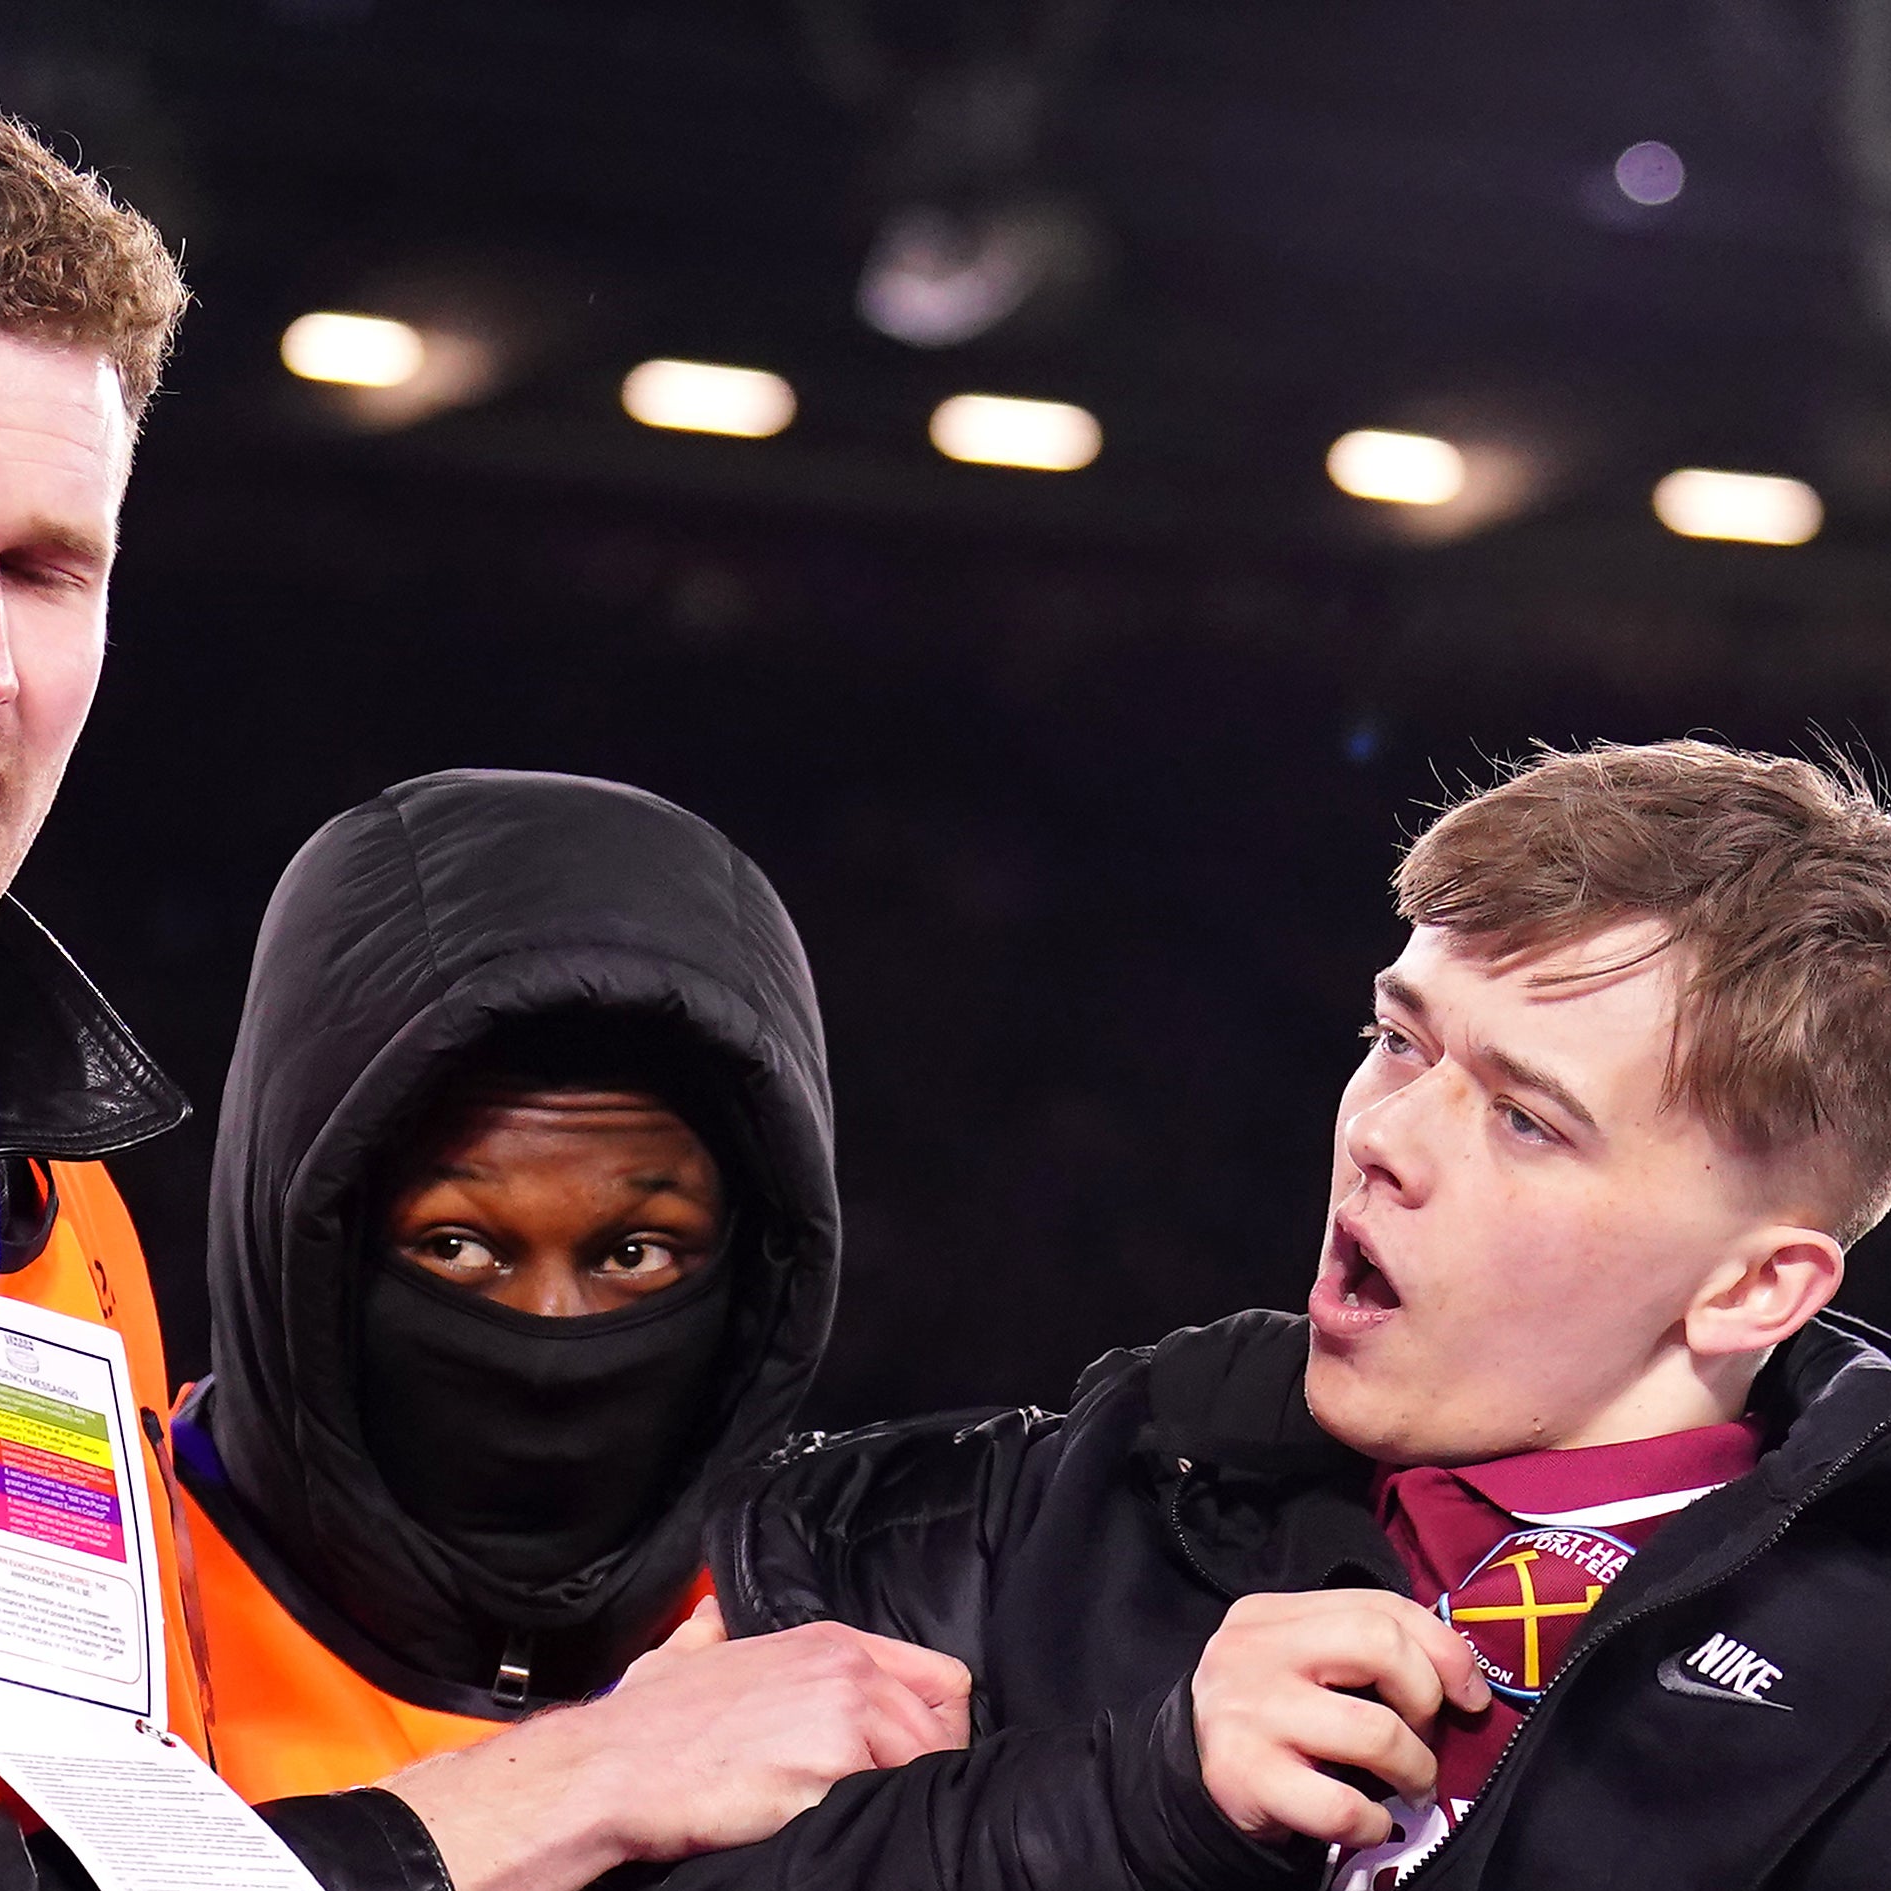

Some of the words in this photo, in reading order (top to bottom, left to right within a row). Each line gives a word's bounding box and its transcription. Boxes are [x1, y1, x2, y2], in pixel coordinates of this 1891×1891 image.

[1514, 1531, 1593, 1549] WEST
[1589, 1541, 1630, 1572] HA
[1533, 1539, 1617, 1585] UNITED
[1685, 1632, 1785, 1702] NIKE
